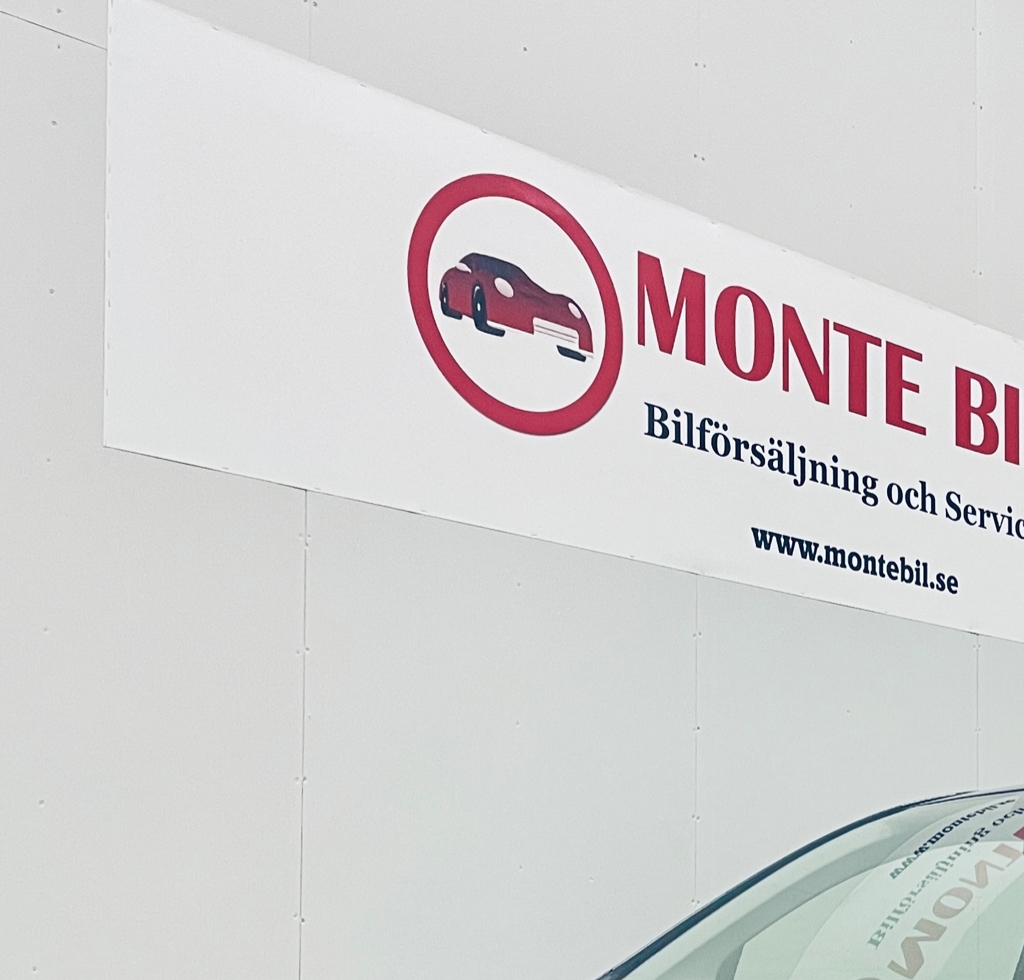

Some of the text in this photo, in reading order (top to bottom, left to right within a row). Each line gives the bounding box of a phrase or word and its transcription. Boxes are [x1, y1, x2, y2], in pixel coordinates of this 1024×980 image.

[638, 251, 927, 437] MONTE
[643, 401, 880, 508] Bilförsäljning
[886, 480, 938, 516] och
[751, 526, 960, 596] www.montebil.se
